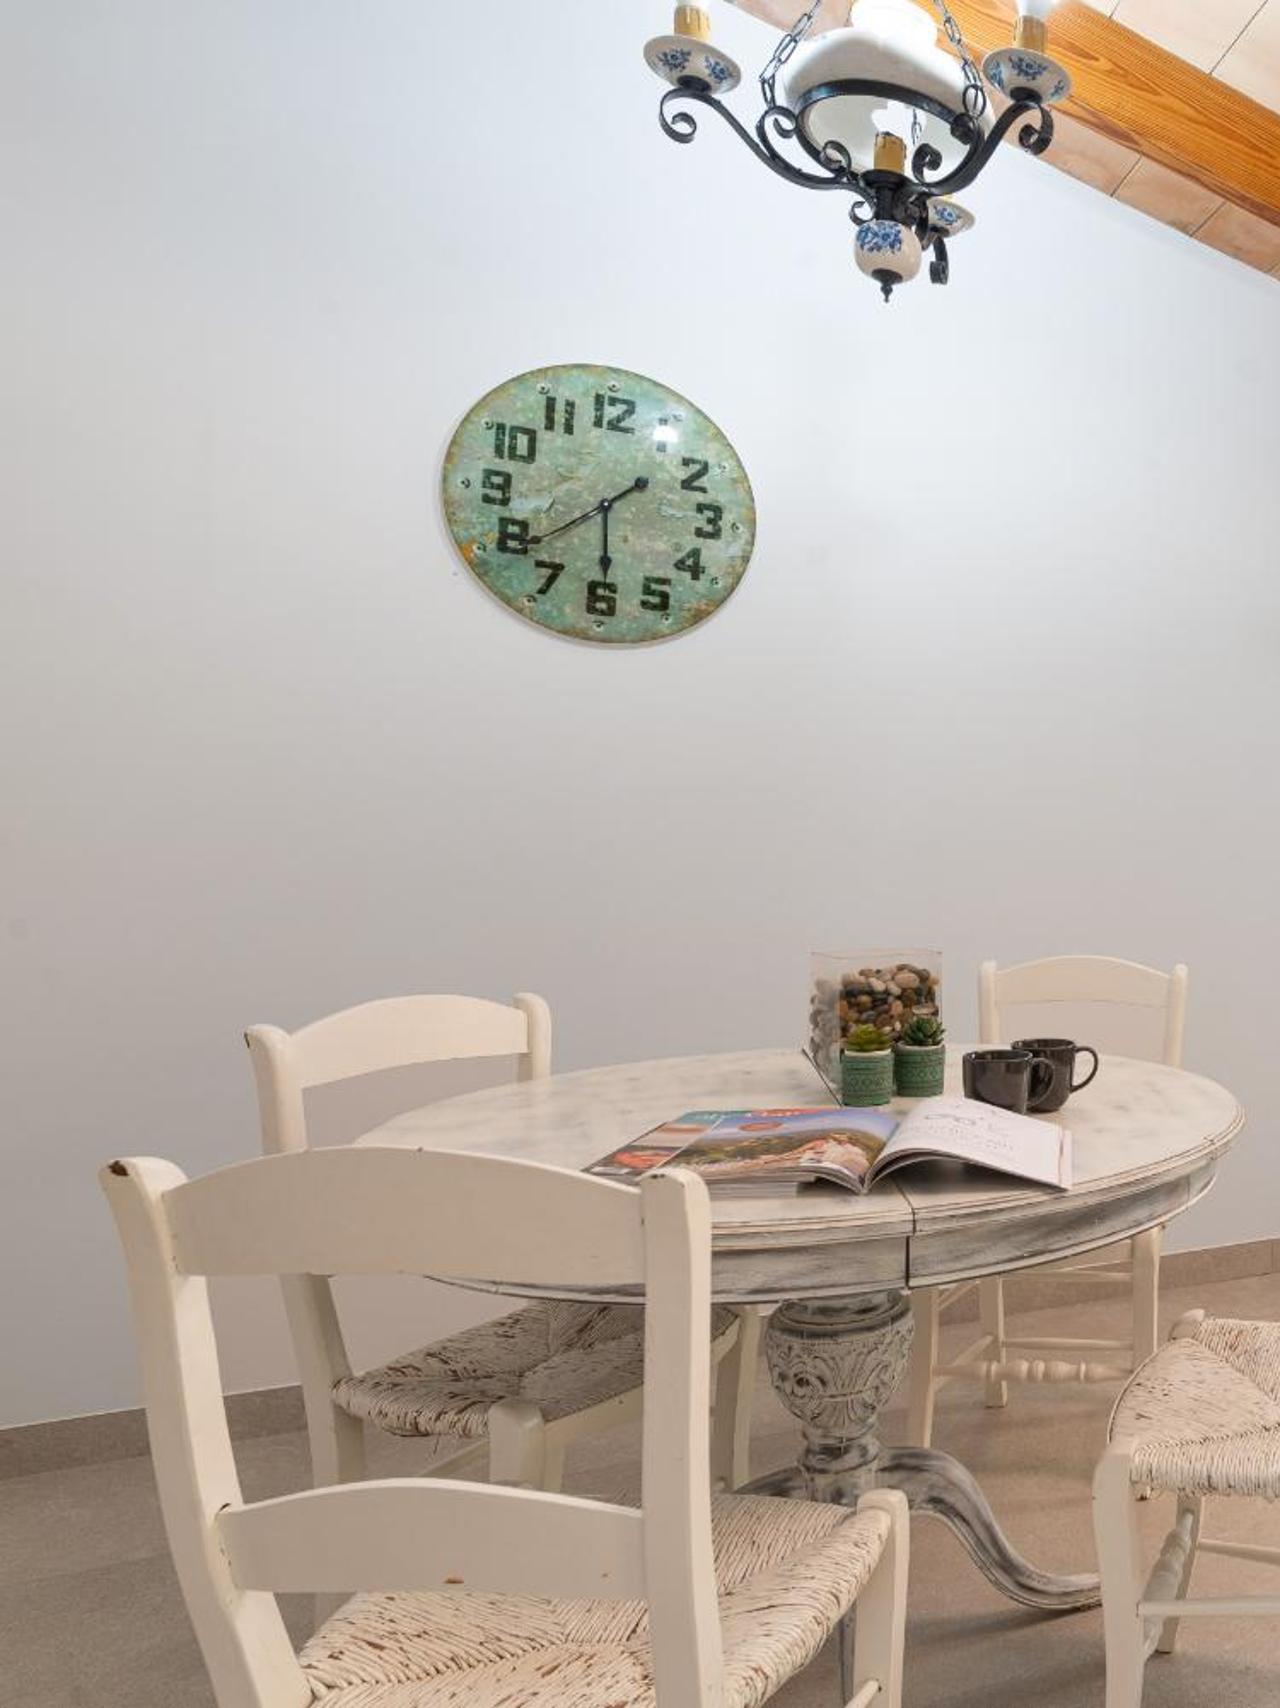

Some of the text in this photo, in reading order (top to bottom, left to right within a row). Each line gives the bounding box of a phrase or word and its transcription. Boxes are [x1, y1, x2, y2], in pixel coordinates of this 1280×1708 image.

[544, 396, 576, 435] 11
[593, 393, 636, 435] 12
[494, 422, 537, 464] 10
[482, 468, 512, 506] 9
[681, 457, 709, 494] 2
[496, 516, 530, 555] 8
[695, 503, 723, 540] 3
[534, 560, 565, 594] 7
[674, 547, 705, 580] 4
[585, 580, 618, 616] 6
[640, 576, 672, 612] 5
